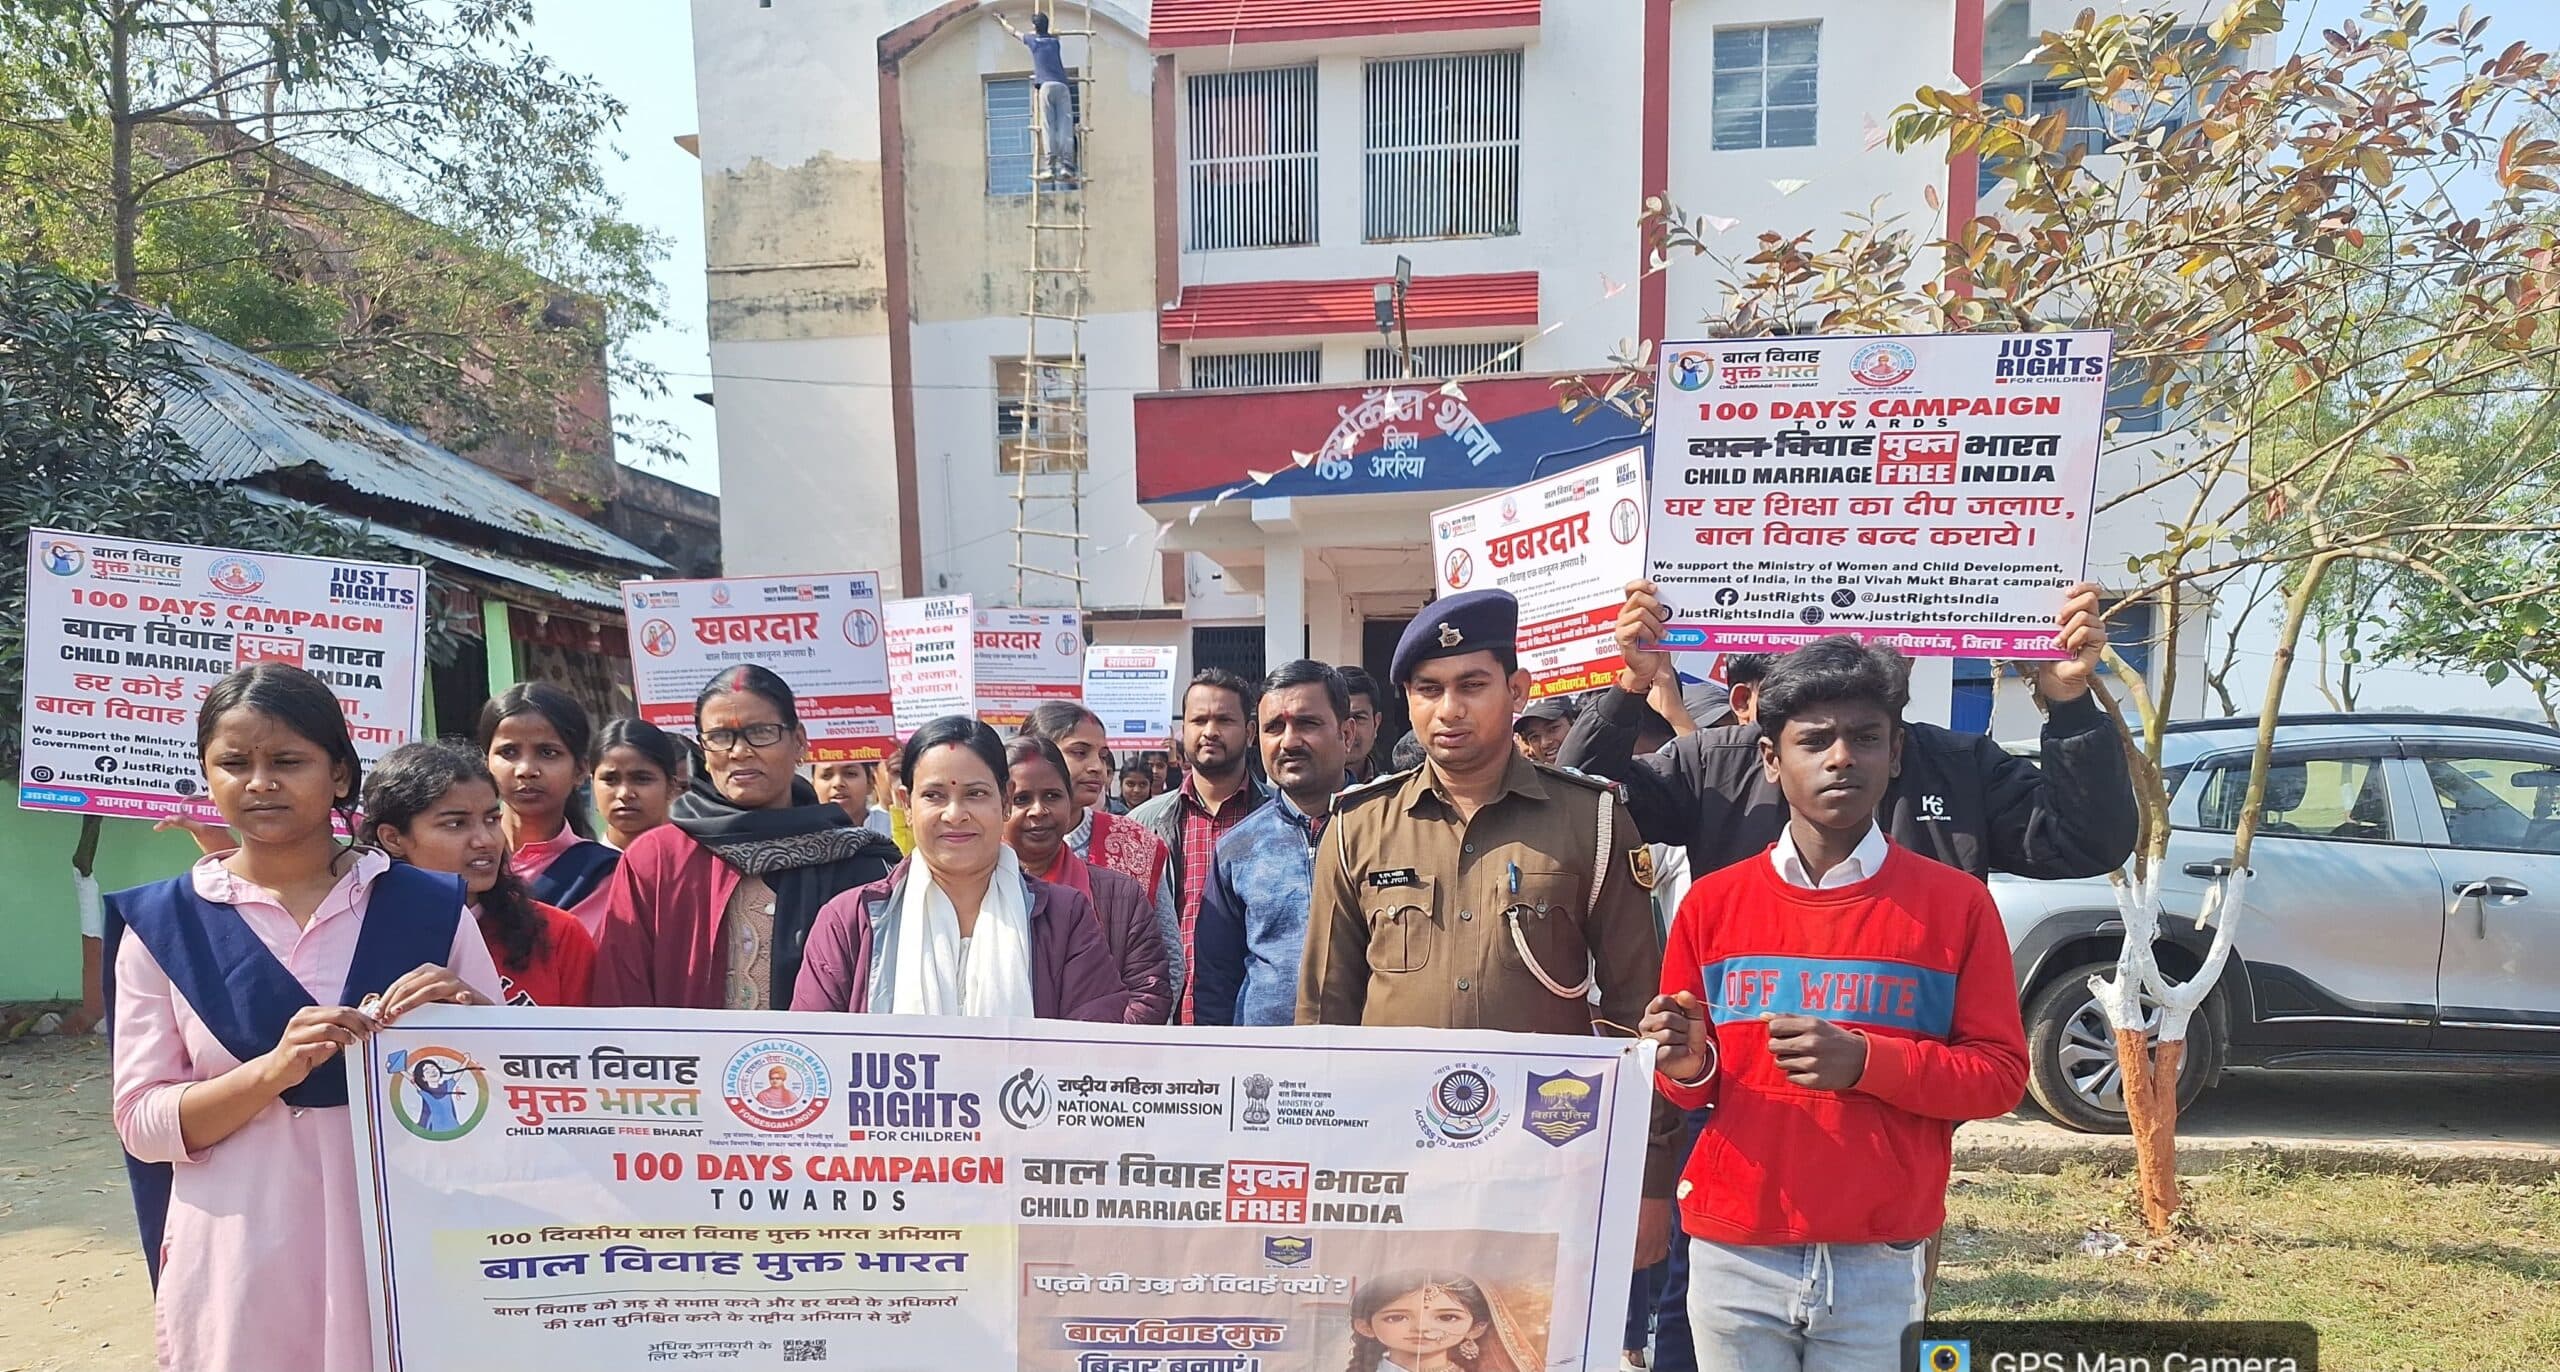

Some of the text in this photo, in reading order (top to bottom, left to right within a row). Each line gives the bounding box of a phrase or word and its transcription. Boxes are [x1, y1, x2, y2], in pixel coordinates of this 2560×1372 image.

[1999, 338, 2073, 357] JUST
[1996, 356, 2104, 377] RIGHTS
[1699, 396, 2061, 421] 100 DAYS CAMPAIGN
[1434, 399, 1501, 467] थाना
[1795, 418, 1948, 430] TOWARDS
[1382, 424, 1419, 450] जिला
[1881, 434, 1957, 461] मुक्त
[1966, 435, 2061, 457] भारत
[1368, 451, 1426, 480] अररिया
[1616, 463, 1630, 475] JUST
[1616, 470, 1636, 484] RIGHTS
[1685, 464, 2055, 484] CHILD MARRIAGE FREE INDIA
[1665, 491, 2075, 519] घर घर शिक्षा का दीप जलाए,
[1486, 511, 1590, 569] खबरदार
[1695, 521, 2035, 546] बाल विवाह बन्द कराये।
[1653, 561, 2063, 574] We support the Ministry of Women and Child Development,
[1652, 575, 2074, 588] Government of India, in the Bal Vivah Mukt Bharat campaign
[925, 600, 954, 610] JUST
[1744, 592, 1999, 605] JustRights @JustRightsIndia
[71, 589, 128, 608] 100
[139, 595, 216, 617] DAYS
[227, 605, 383, 633] CAMPAIGN
[924, 606, 968, 618] RIGHTS
[1678, 608, 1795, 621] JustRightsIndia
[692, 612, 820, 645] खबरदार
[62, 618, 137, 642] बाल
[144, 621, 234, 653] विवाह
[239, 636, 301, 659] मुक्त
[309, 644, 386, 668] भारत
[60, 645, 119, 665] CHILD
[126, 652, 232, 674] MARRIAGE
[915, 654, 955, 664] INDIA
[1726, 970, 1918, 1017] OFF WHITE
[500, 1046, 700, 1084] बाल विवाह
[727, 1042, 826, 1096] JAGRAN KALYAN BHARTI
[849, 1053, 940, 1089] JUST
[1057, 1075, 1220, 1097] राष्ट्रीय महिला आयोग
[504, 1086, 701, 1126] मुक्त भारत
[849, 1092, 980, 1128] RIGHTS
[1058, 1101, 1223, 1116] NATIONAL COMMISSION
[1277, 1108, 1335, 1117] WOMEN AND
[1278, 1100, 1311, 1108] MINISTRY
[1531, 1109, 1591, 1121] बिहार पुलिस
[506, 1127, 703, 1137] CHILD MARRIAGE FREE BHARAT
[1057, 1114, 1145, 1128] FOR WOMEN
[1277, 1117, 1368, 1128] CHILD DEVELOPMENT
[1414, 1109, 1510, 1149] ACCESS TO JUSTICE FOR ALL
[869, 1131, 972, 1142] FOR CHILDREN
[613, 1152, 1005, 1184] 100 DAYS CAMPAIGN
[1022, 1153, 1408, 1195] बाल विवाह मुक्त भारत
[711, 1189, 906, 1211] TOWARDS
[1021, 1197, 1403, 1224] CHILD MARRIAGE FREE INDIA
[487, 1226, 962, 1245] 100 दिवसीय बाल विवाह मुक्त भारत अभियान
[480, 1245, 969, 1281] बाल विवाह मुक्त भारत
[1034, 1273, 1091, 1296] पढ़ने
[1098, 1272, 1130, 1293] की
[1138, 1277, 1177, 1294] उम्र
[1181, 1273, 1209, 1293] में
[1211, 1273, 1277, 1293] विदाई
[1281, 1274, 1330, 1294] क्यों
[1065, 1319, 1285, 1347] बाल विवाह मुक्त
